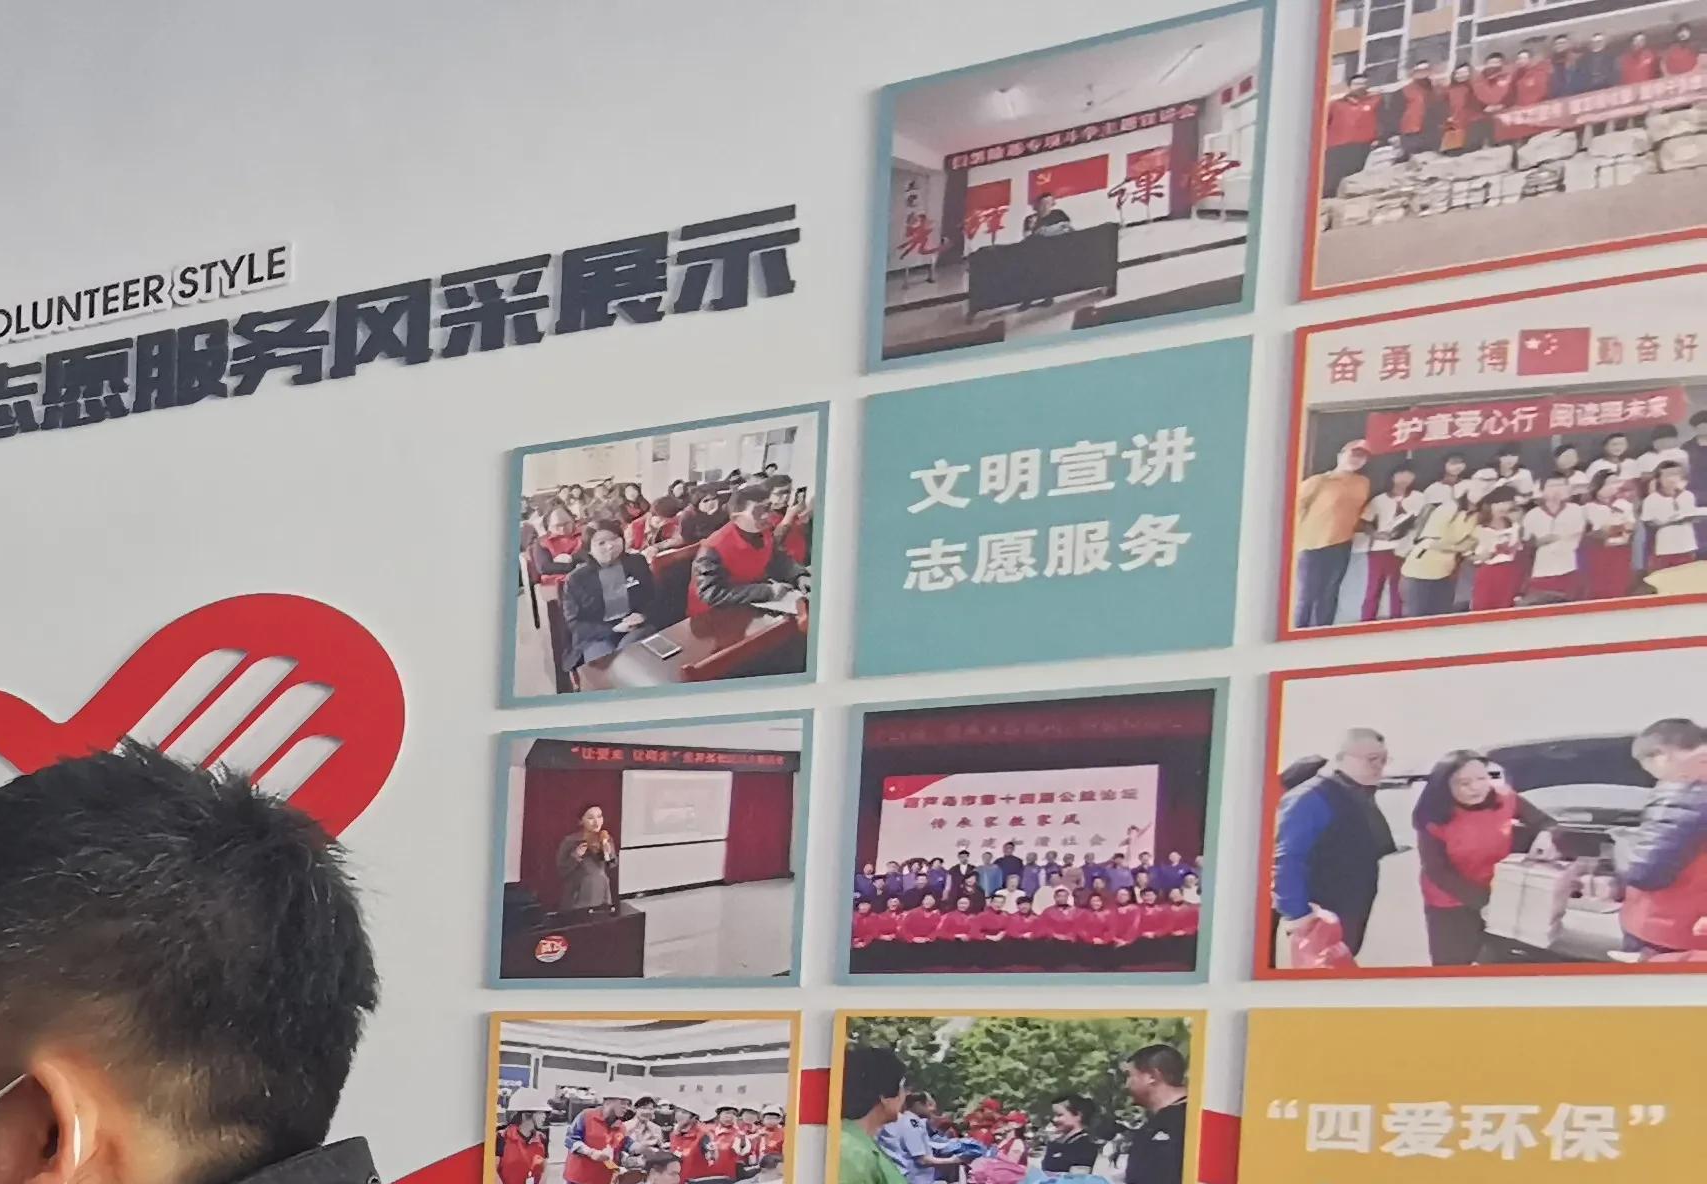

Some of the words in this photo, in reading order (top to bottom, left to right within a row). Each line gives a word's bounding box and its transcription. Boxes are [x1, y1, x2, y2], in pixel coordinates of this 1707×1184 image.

[177, 246, 287, 299] STYLE
[1327, 338, 1510, 385] 奋勇拼搏
[907, 425, 1196, 513] 文明宣讲
[903, 512, 1192, 592] 志愿服务
[1267, 1098, 1669, 1163] “四爱环保”
